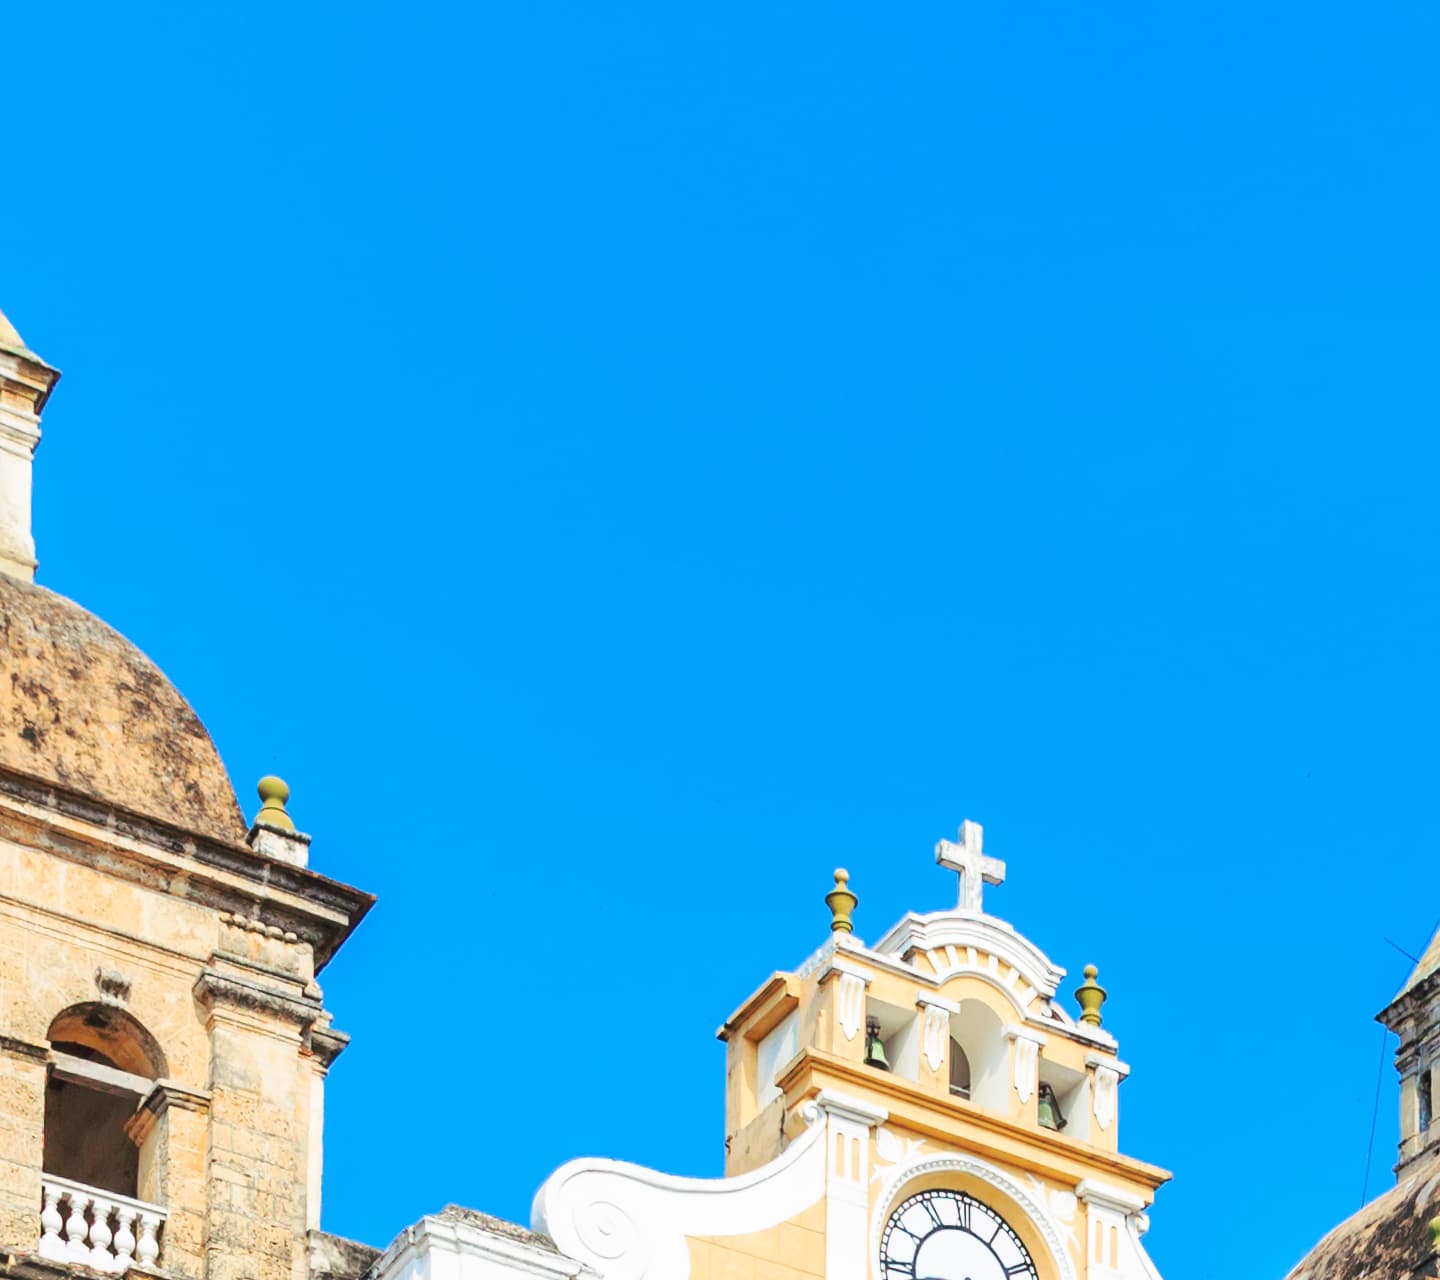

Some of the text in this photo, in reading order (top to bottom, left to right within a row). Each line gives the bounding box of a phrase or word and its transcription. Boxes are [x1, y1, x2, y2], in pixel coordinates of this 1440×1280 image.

[955, 1199, 971, 1231] XII
[894, 1218, 923, 1247] X
[988, 1223, 1002, 1246] I
[1006, 1262, 1030, 1275] II
